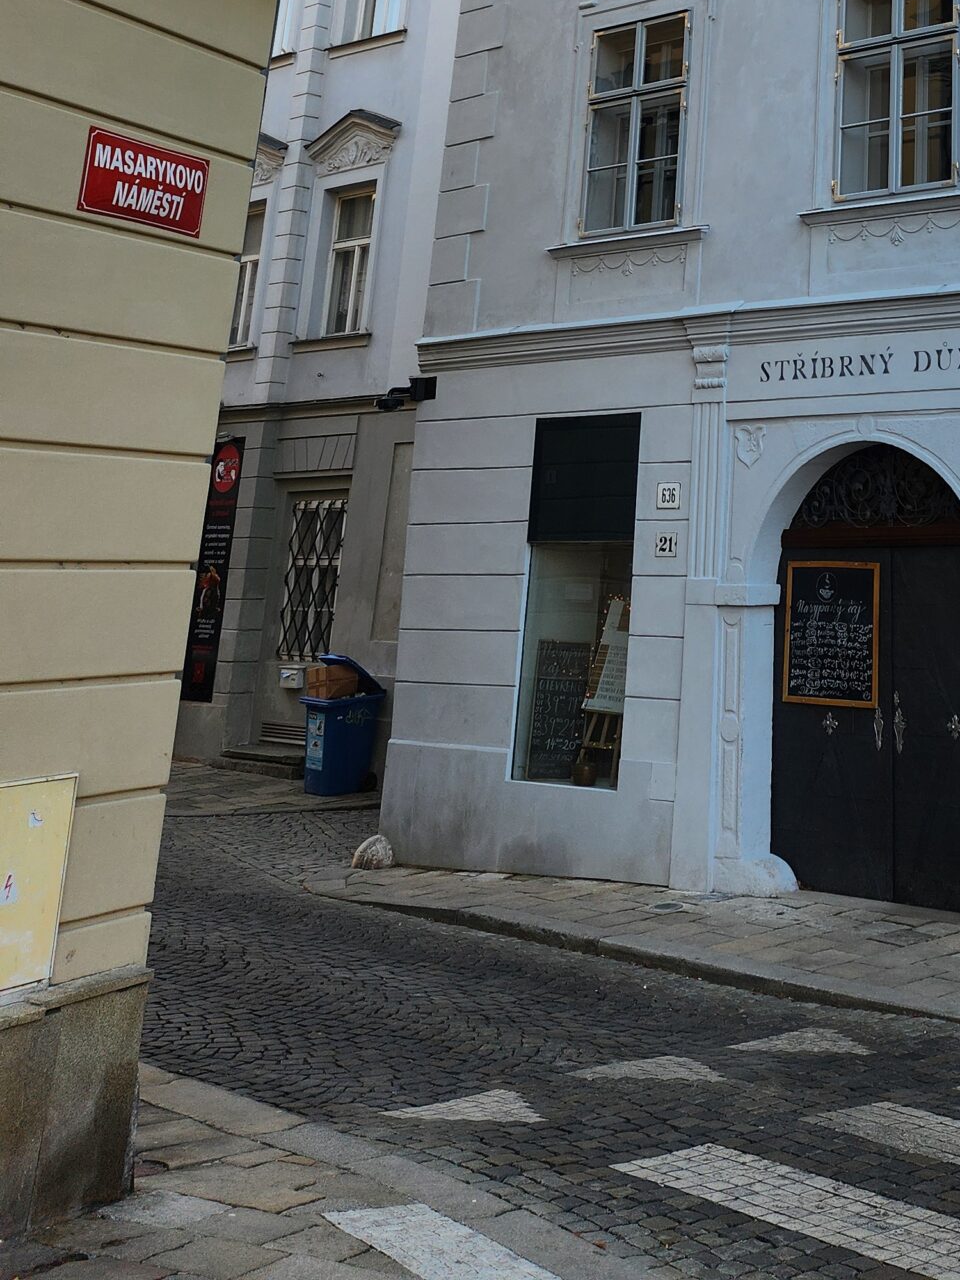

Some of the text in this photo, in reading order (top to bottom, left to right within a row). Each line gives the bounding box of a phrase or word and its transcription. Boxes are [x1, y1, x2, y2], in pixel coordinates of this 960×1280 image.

[94, 143, 204, 194] MASARYKOVO
[112, 179, 186, 221] NÁMĚSTÍ
[759, 346, 894, 383] STŘÍBRNÝ
[661, 487, 676, 504] 636
[658, 536, 673, 553] 21
